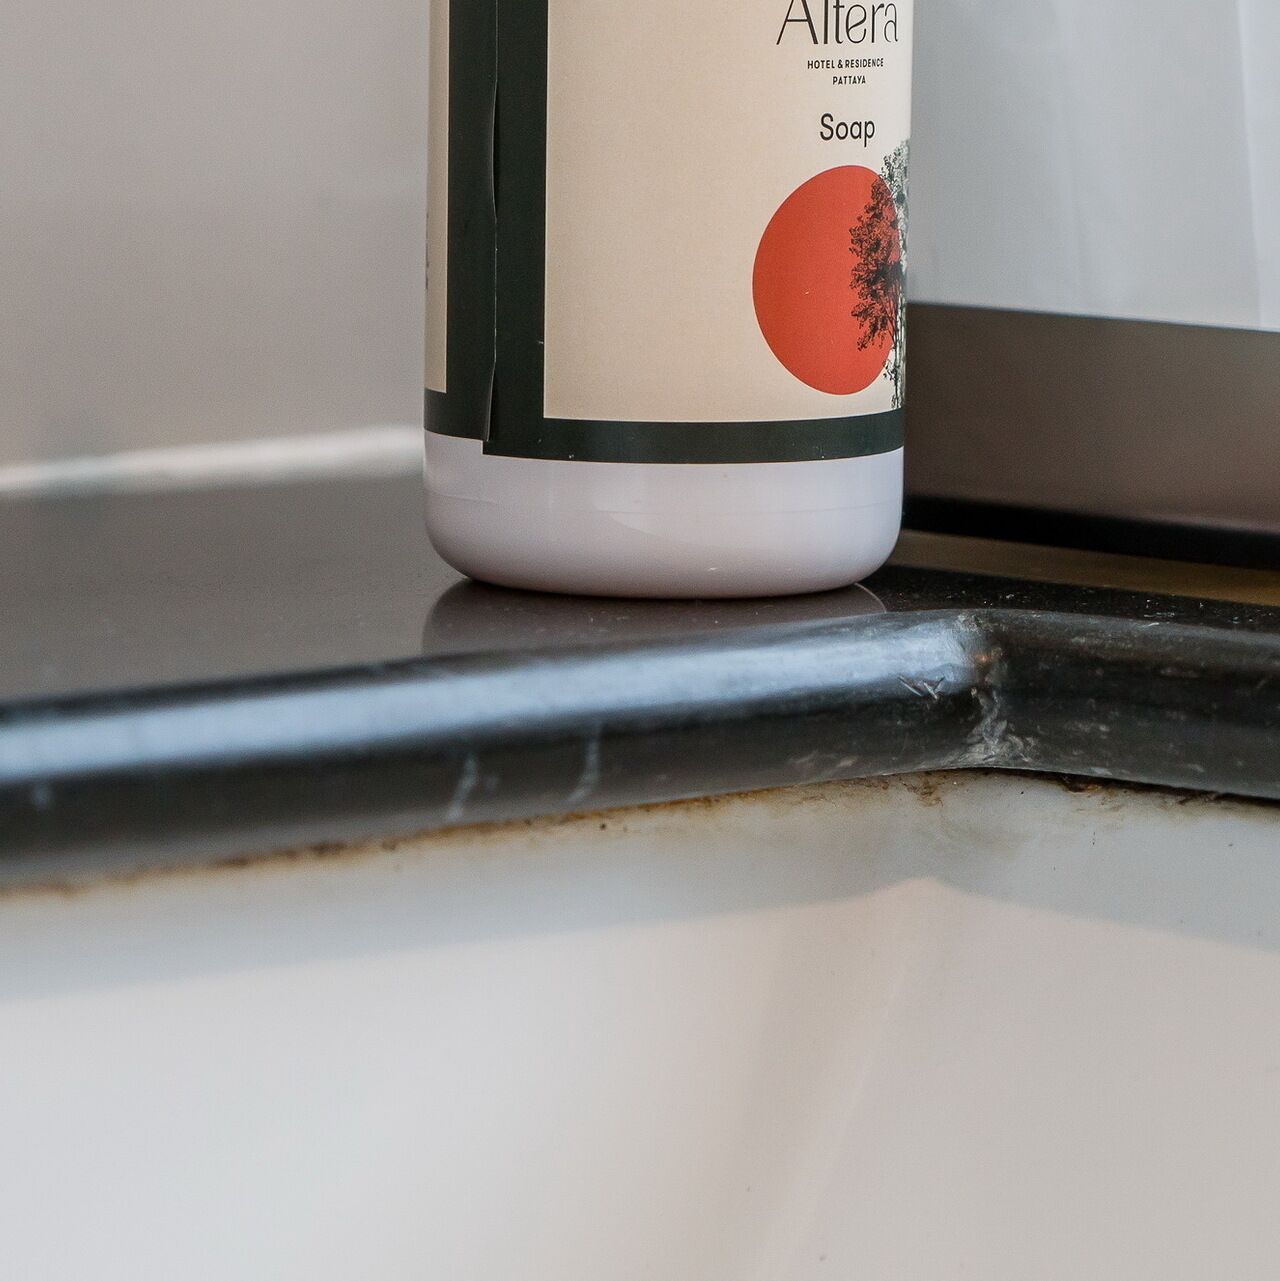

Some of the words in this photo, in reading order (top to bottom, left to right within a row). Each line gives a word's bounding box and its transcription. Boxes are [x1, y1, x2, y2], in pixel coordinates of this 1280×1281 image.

[807, 59, 835, 70] HOTEL
[837, 59, 844, 69] &
[845, 57, 885, 69] RESIDENCE
[832, 75, 867, 86] PATTAYA
[819, 112, 876, 148] Soap
